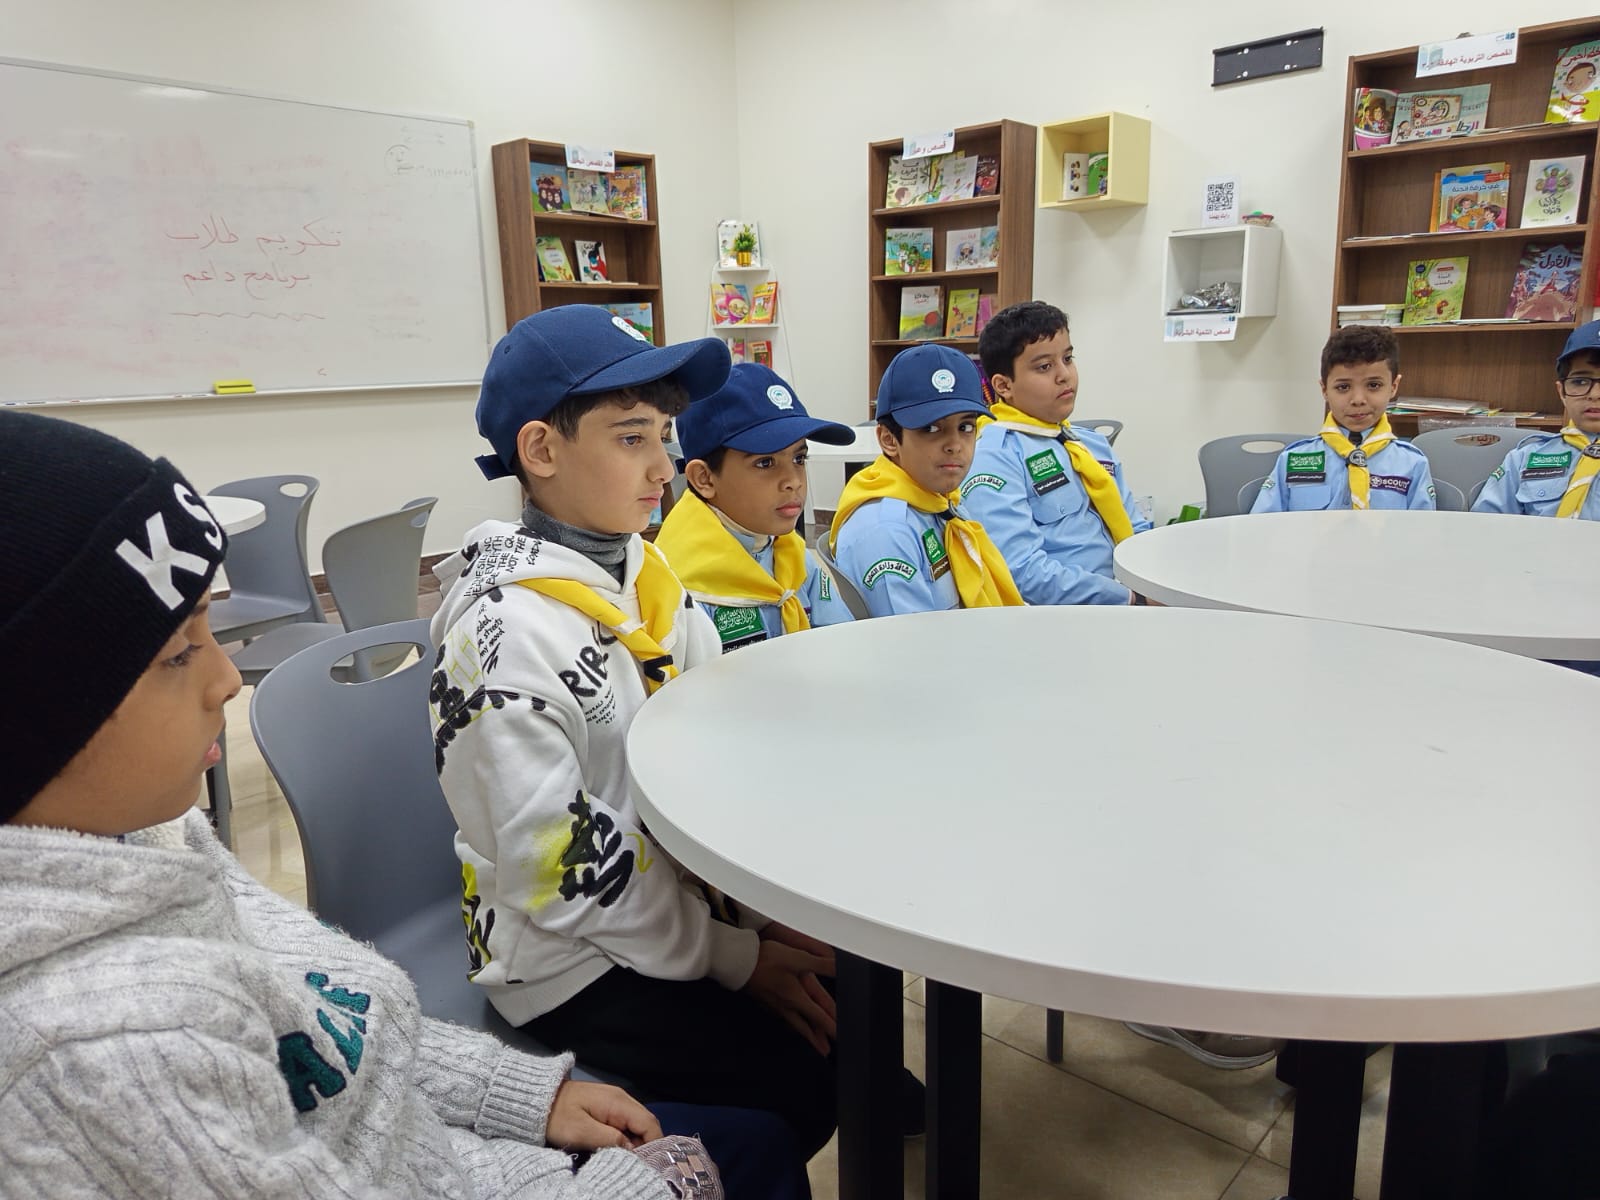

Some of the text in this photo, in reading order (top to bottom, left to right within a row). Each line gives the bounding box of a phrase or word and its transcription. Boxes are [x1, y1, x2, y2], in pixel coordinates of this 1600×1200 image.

[1538, 254, 1572, 270] الغول
[505, 537, 527, 573] NOT THE
